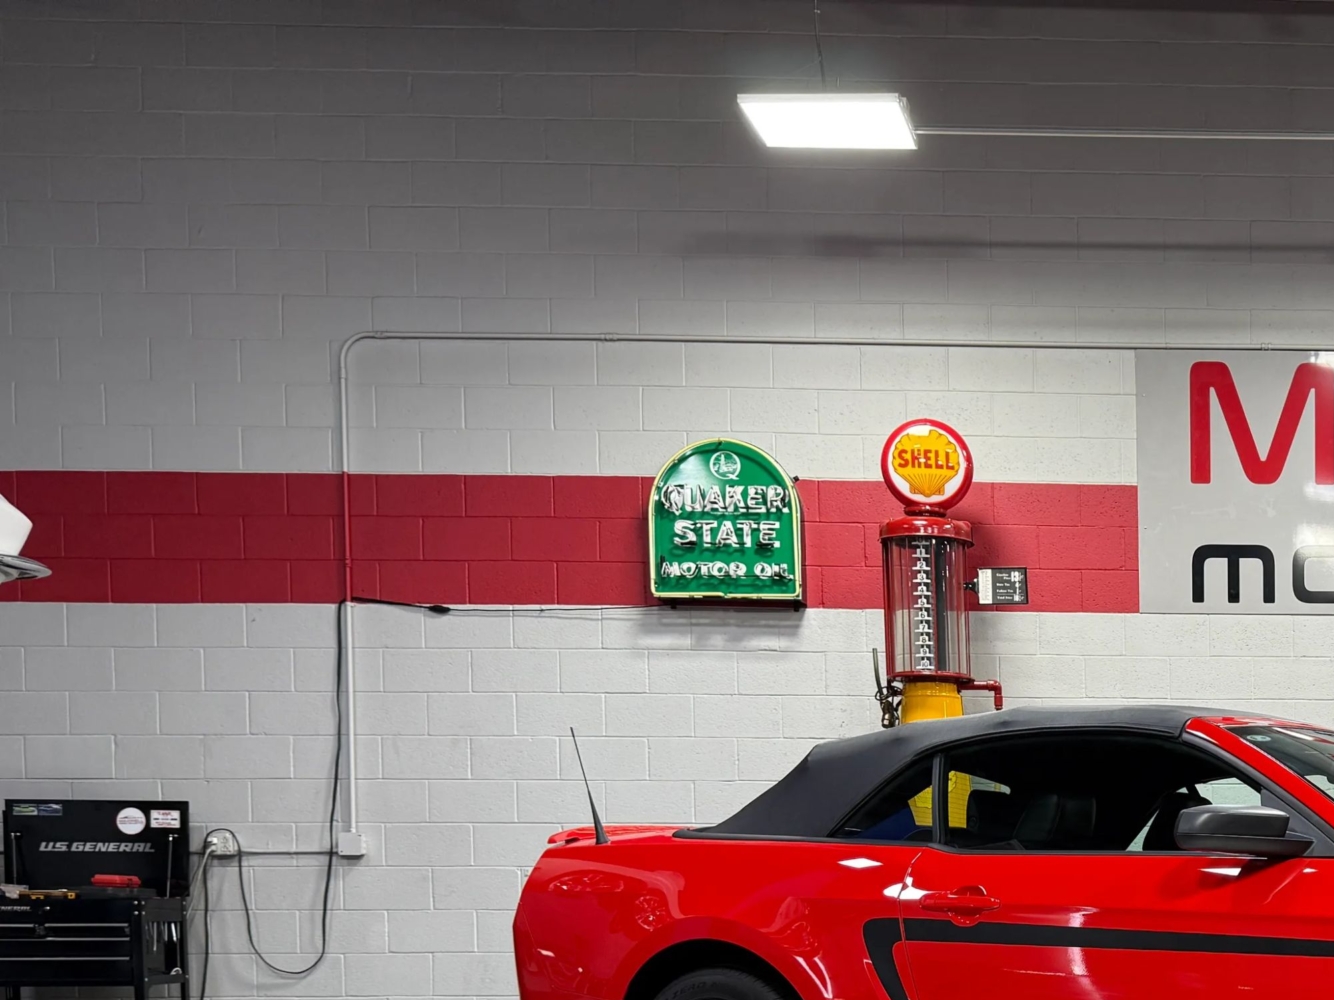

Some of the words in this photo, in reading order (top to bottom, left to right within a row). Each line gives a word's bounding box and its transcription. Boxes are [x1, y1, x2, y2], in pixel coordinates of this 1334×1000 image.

[896, 448, 956, 472] SHELL
[661, 484, 790, 516] QUAKER
[673, 520, 781, 548] STATE
[661, 561, 746, 579] MOTOR
[754, 562, 794, 579] OIL
[70, 842, 155, 852] GENERAL
